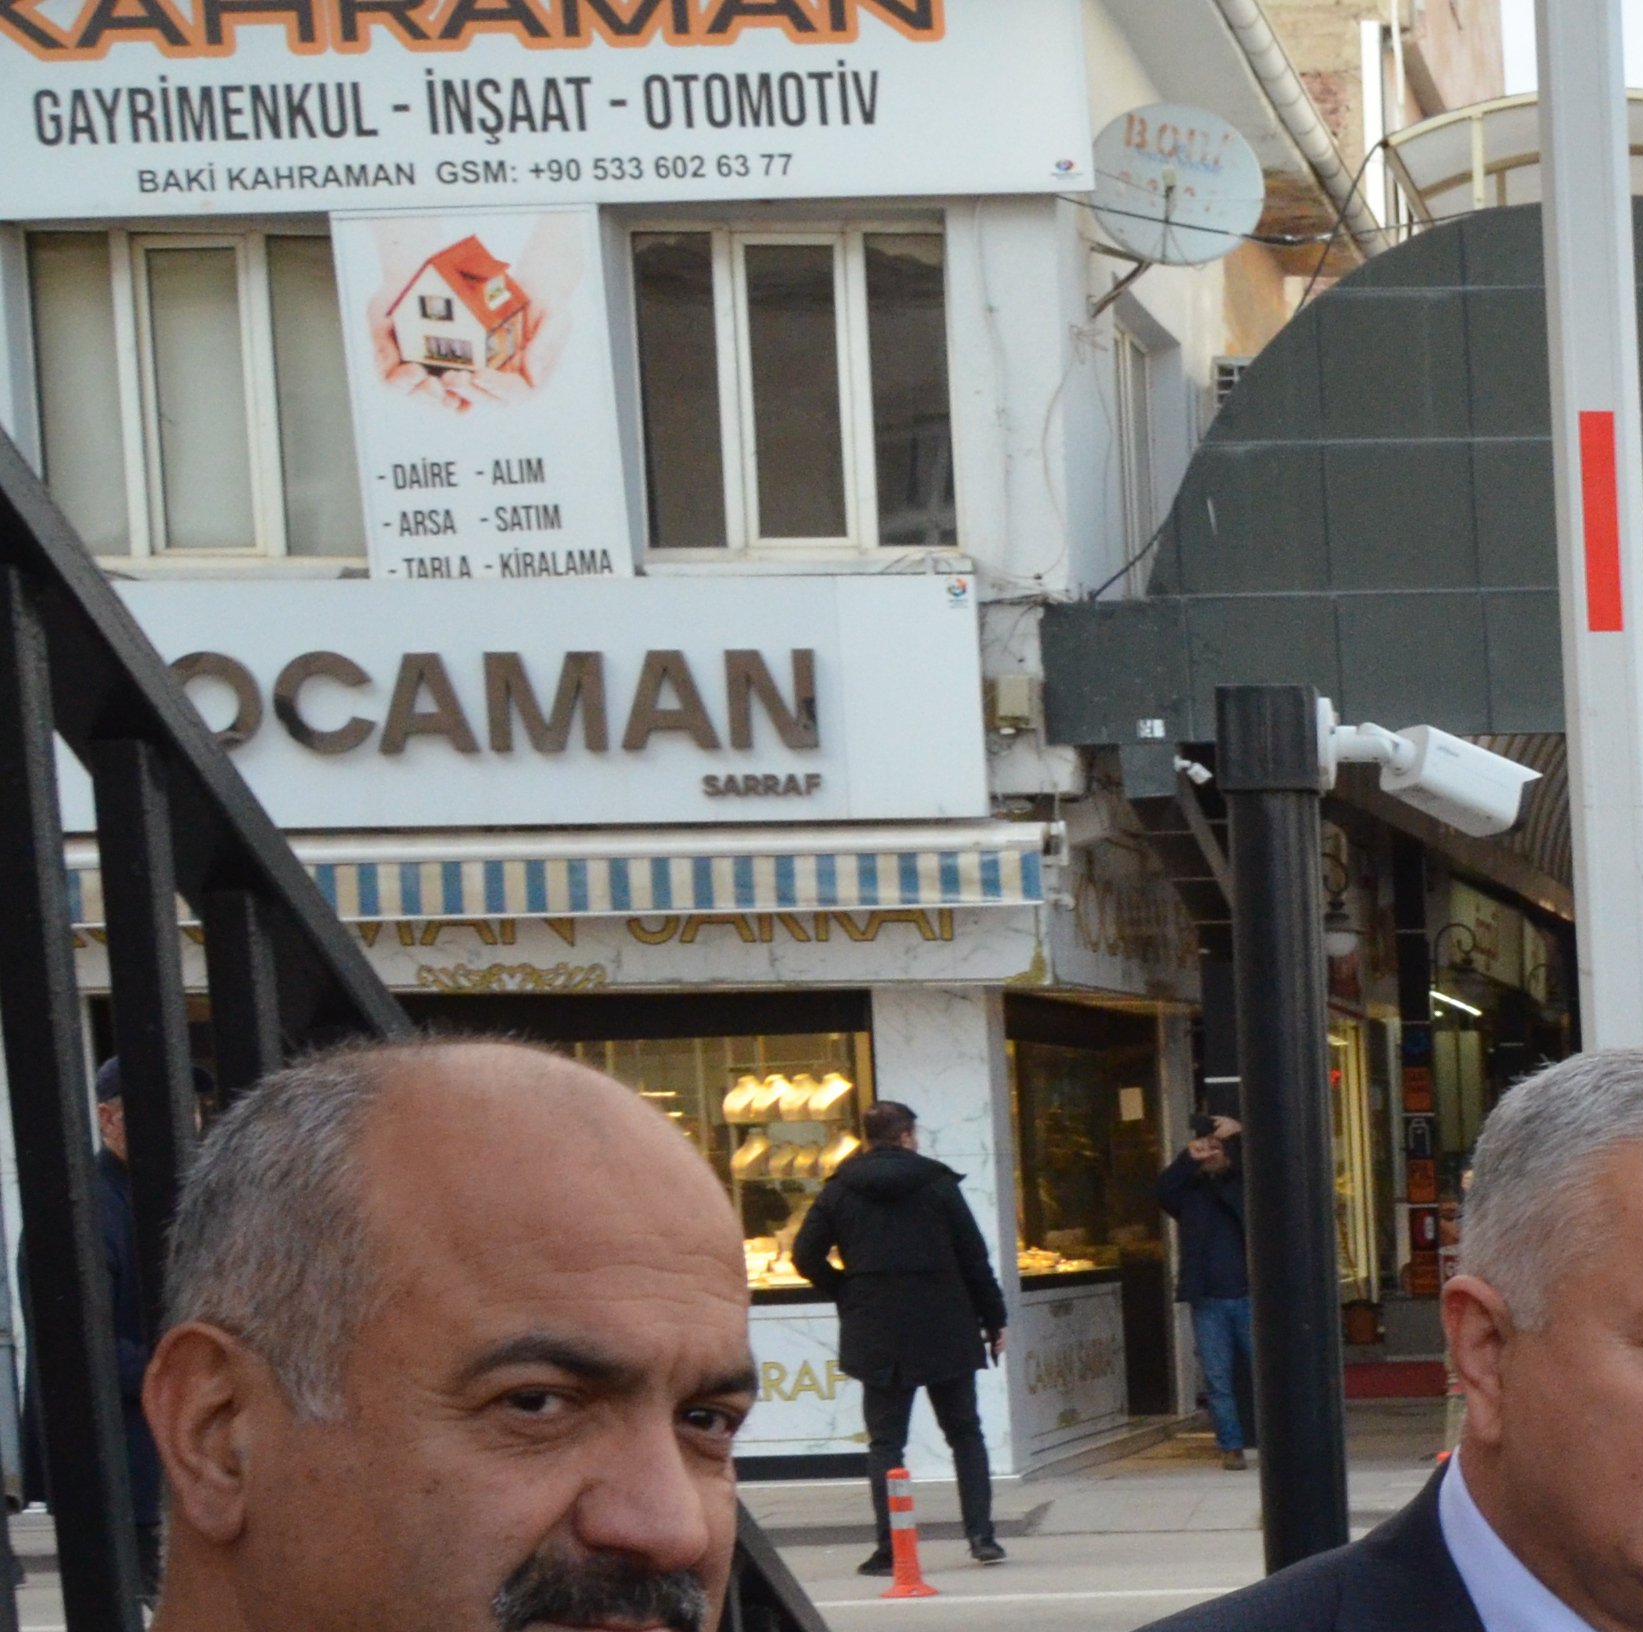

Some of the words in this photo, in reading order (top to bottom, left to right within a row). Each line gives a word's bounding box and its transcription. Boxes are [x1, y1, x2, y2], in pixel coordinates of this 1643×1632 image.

[0, 0, 946, 60] AHRAMAN
[34, 75, 379, 147] GAYRİMENKUL
[426, 68, 592, 145] İNŞAAT
[643, 59, 879, 130] OTOMOTİV
[137, 162, 217, 194] BAKİ
[227, 162, 416, 192] KAHRAMAN
[436, 160, 518, 186] GSM:
[529, 158, 582, 183] +90
[592, 156, 645, 181] 533
[654, 154, 707, 180] 602
[716, 153, 751, 178] 63
[760, 152, 794, 177] 77
[392, 457, 459, 491] DAİRE
[492, 457, 546, 486] ALIM
[399, 509, 457, 537] ARSA
[495, 503, 562, 532] SATIM
[499, 547, 614, 578] KİRALAMA
[702, 772, 823, 799] SARRAF
[757, 1359, 848, 1402] RAF
